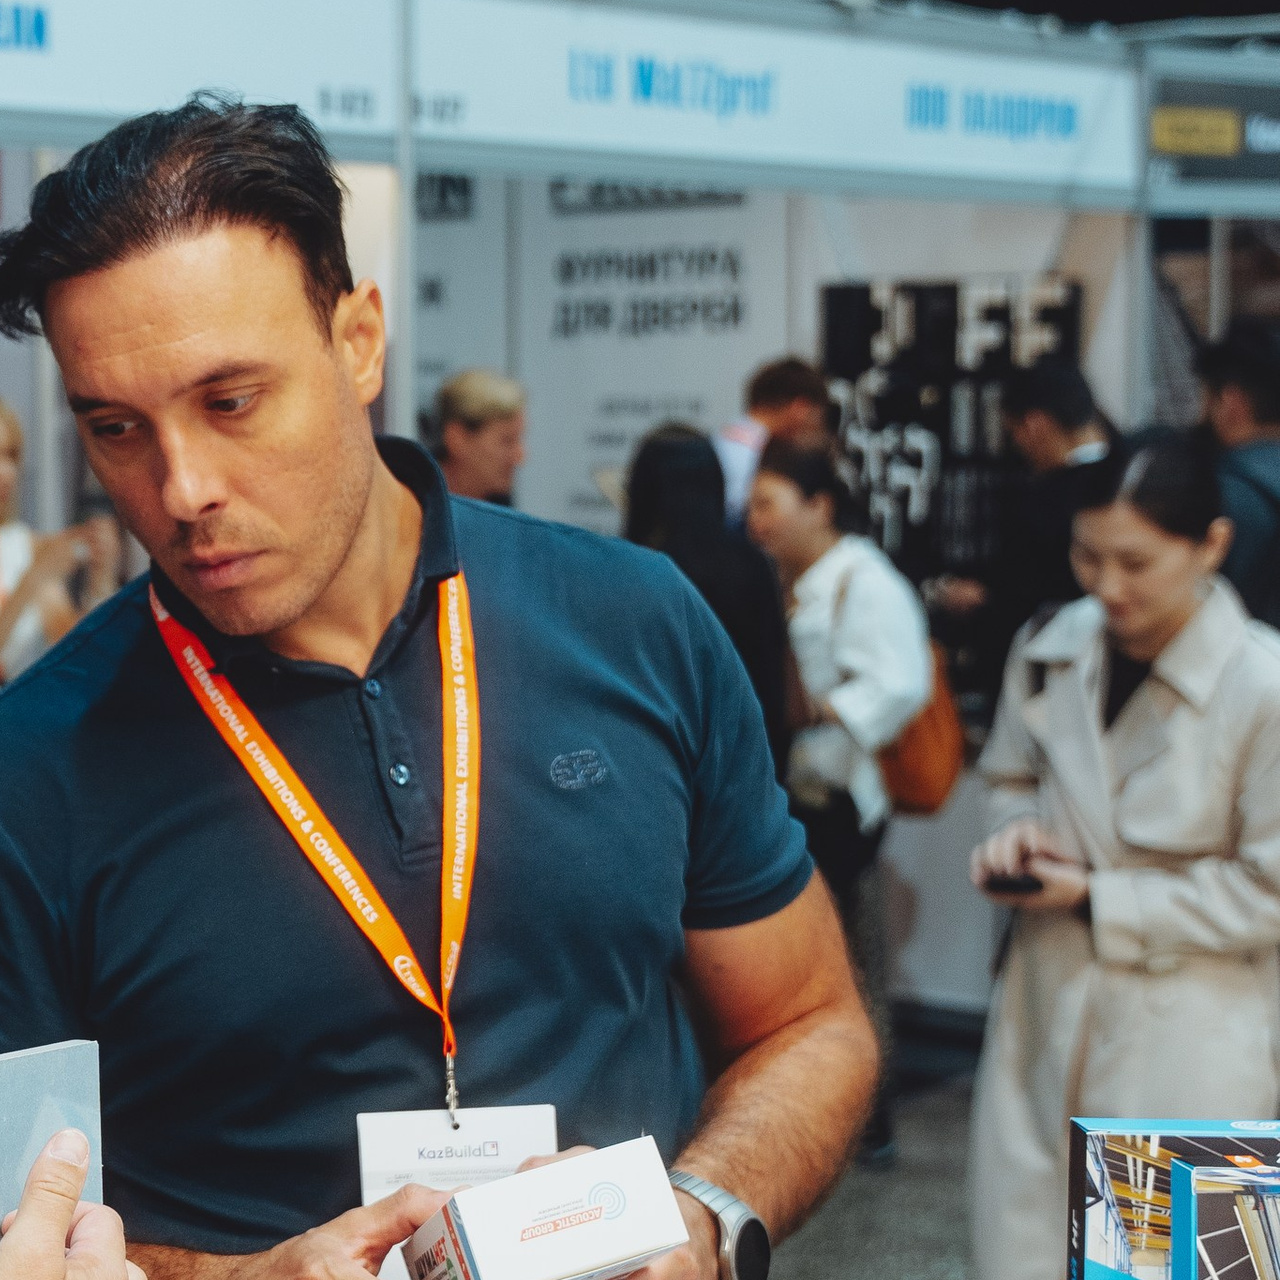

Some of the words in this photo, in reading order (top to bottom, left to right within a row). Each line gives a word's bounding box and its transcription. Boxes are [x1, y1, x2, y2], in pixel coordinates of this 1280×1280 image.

[453, 674, 467, 687] &
[454, 686, 469, 779] EXHIBITIONS
[181, 645, 249, 743] INTERNATIONAL
[245, 740, 307, 822] EXHIBITIONS
[300, 818, 315, 834] &
[309, 830, 380, 924] CONFERENCES
[452, 780, 469, 900] INTERNATIONAL
[417, 1145, 483, 1161] KazBuild
[556, 1207, 601, 1230] ACOUSTIC
[521, 1220, 556, 1241] GROUP
